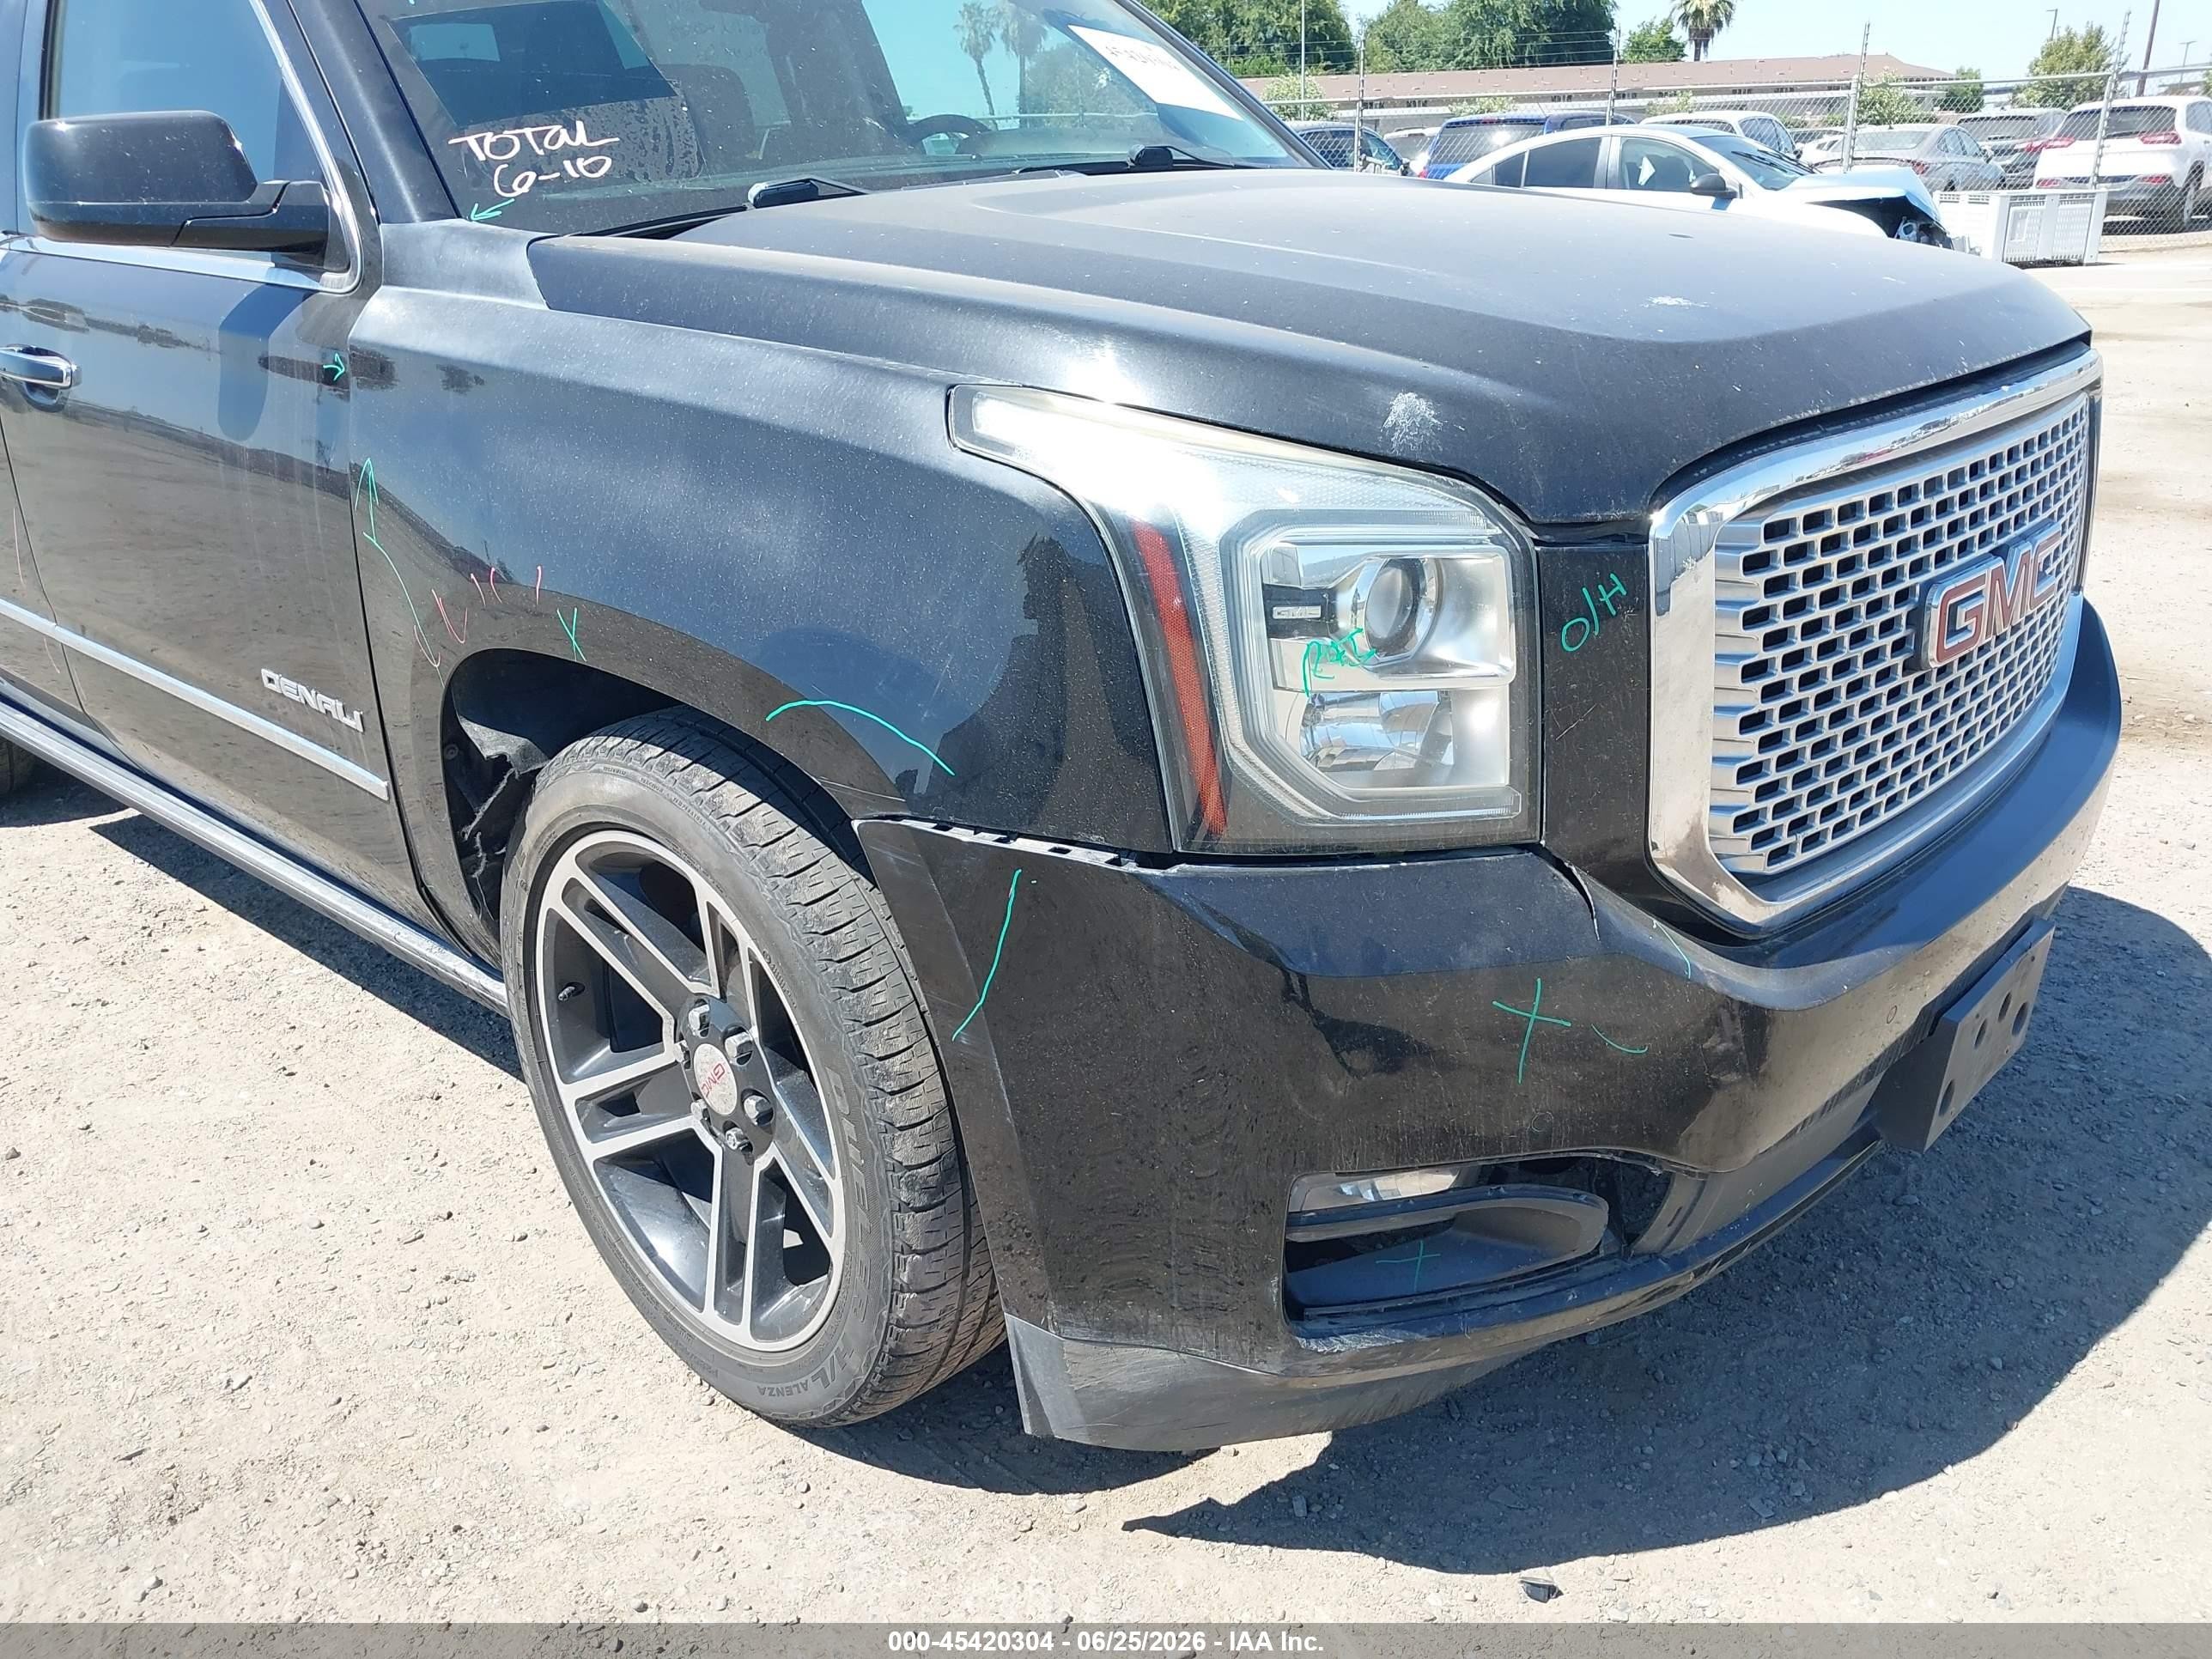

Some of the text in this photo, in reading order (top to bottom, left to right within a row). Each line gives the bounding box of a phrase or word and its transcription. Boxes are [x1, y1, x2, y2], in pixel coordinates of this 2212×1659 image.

[494, 156, 612, 197] 6-10
[1931, 526, 2062, 665] GMC
[260, 668, 364, 733] DENALI
[701, 1063, 726, 1098] GMC
[757, 1378, 810, 1398] ALENZA
